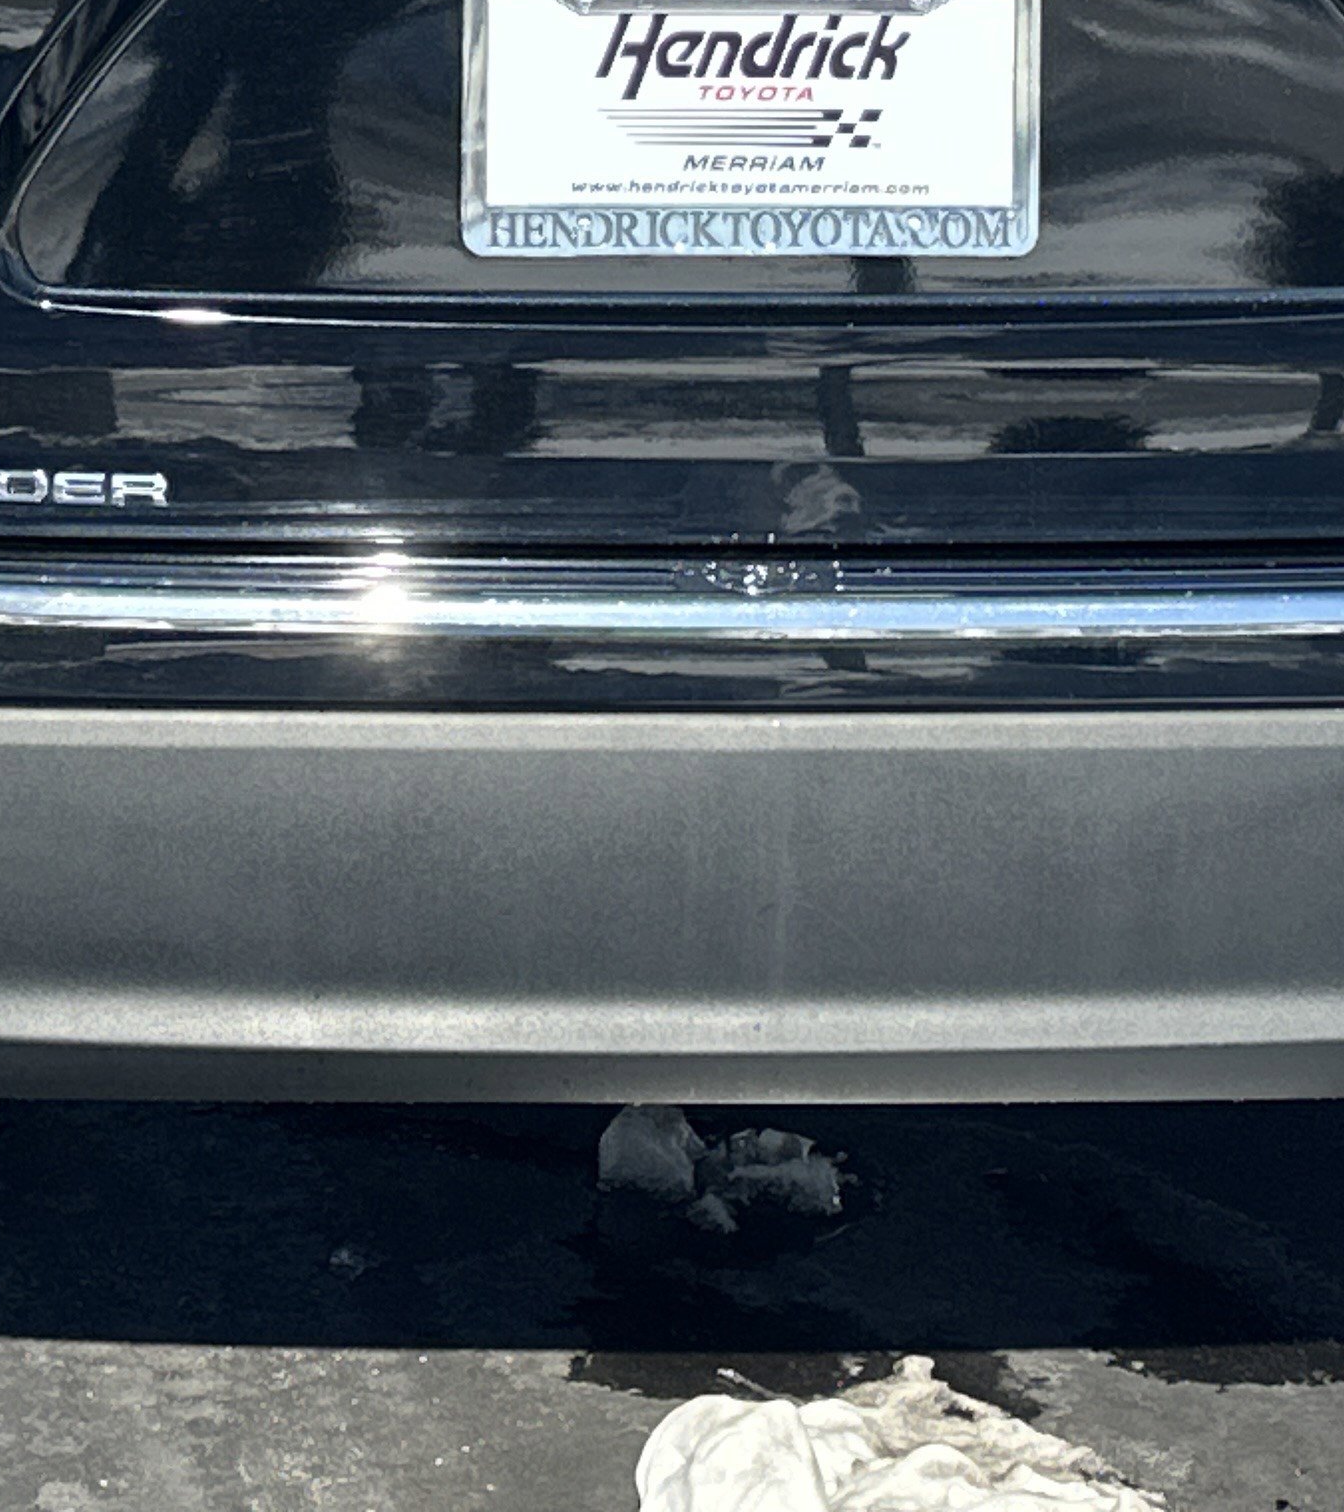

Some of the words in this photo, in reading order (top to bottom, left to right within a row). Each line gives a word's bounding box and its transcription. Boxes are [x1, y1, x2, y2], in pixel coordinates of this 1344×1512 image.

[595, 13, 912, 100] Hendrick
[698, 85, 814, 102] TOYOTA
[683, 155, 826, 172] MERRIAM
[571, 179, 930, 195] www.hendricktoyotamerriam.com
